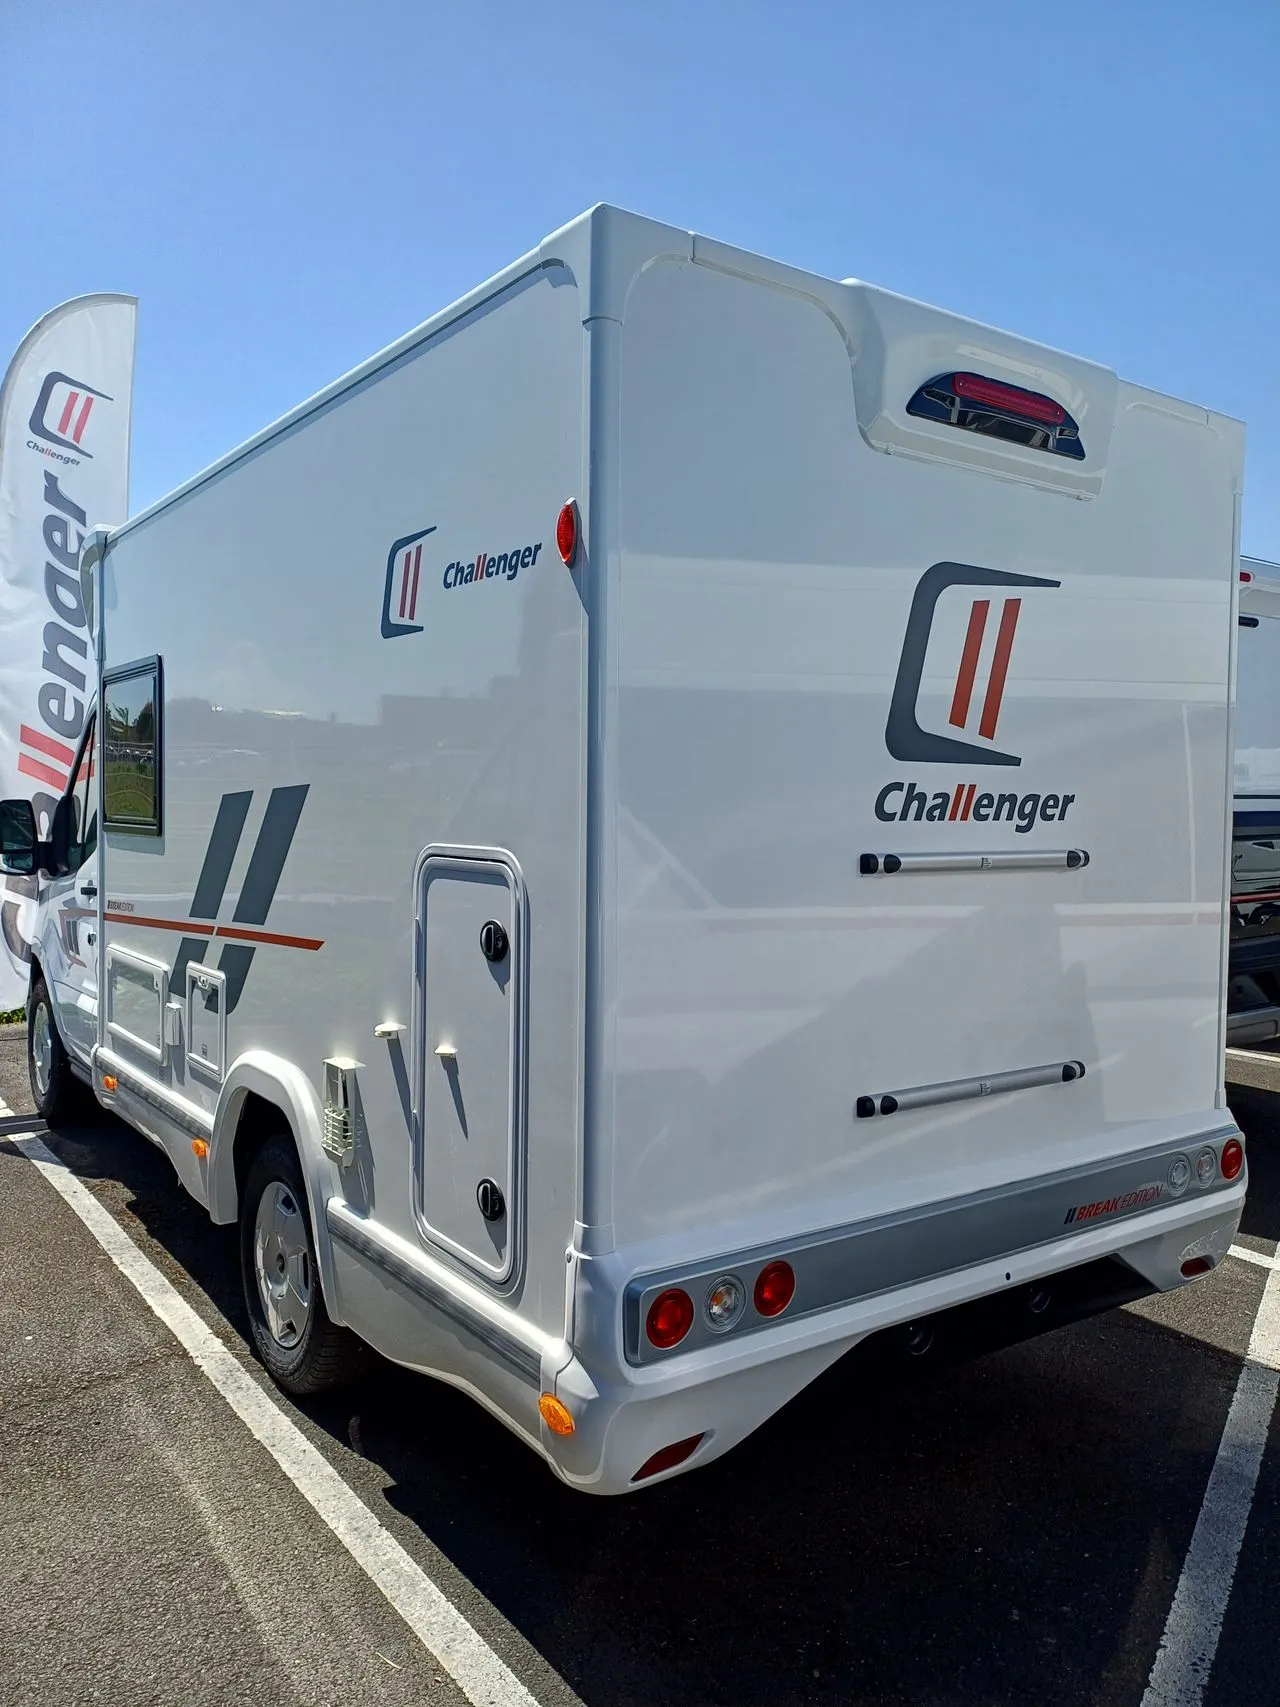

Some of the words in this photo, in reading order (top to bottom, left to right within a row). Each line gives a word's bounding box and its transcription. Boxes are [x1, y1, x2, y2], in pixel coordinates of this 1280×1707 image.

[26, 440, 80, 466] Challenger
[443, 543, 542, 589] Challenger
[874, 781, 1075, 833] Challenger
[1076, 1197, 1120, 1220] BREAK
[1120, 1184, 1163, 1208] EDITION
